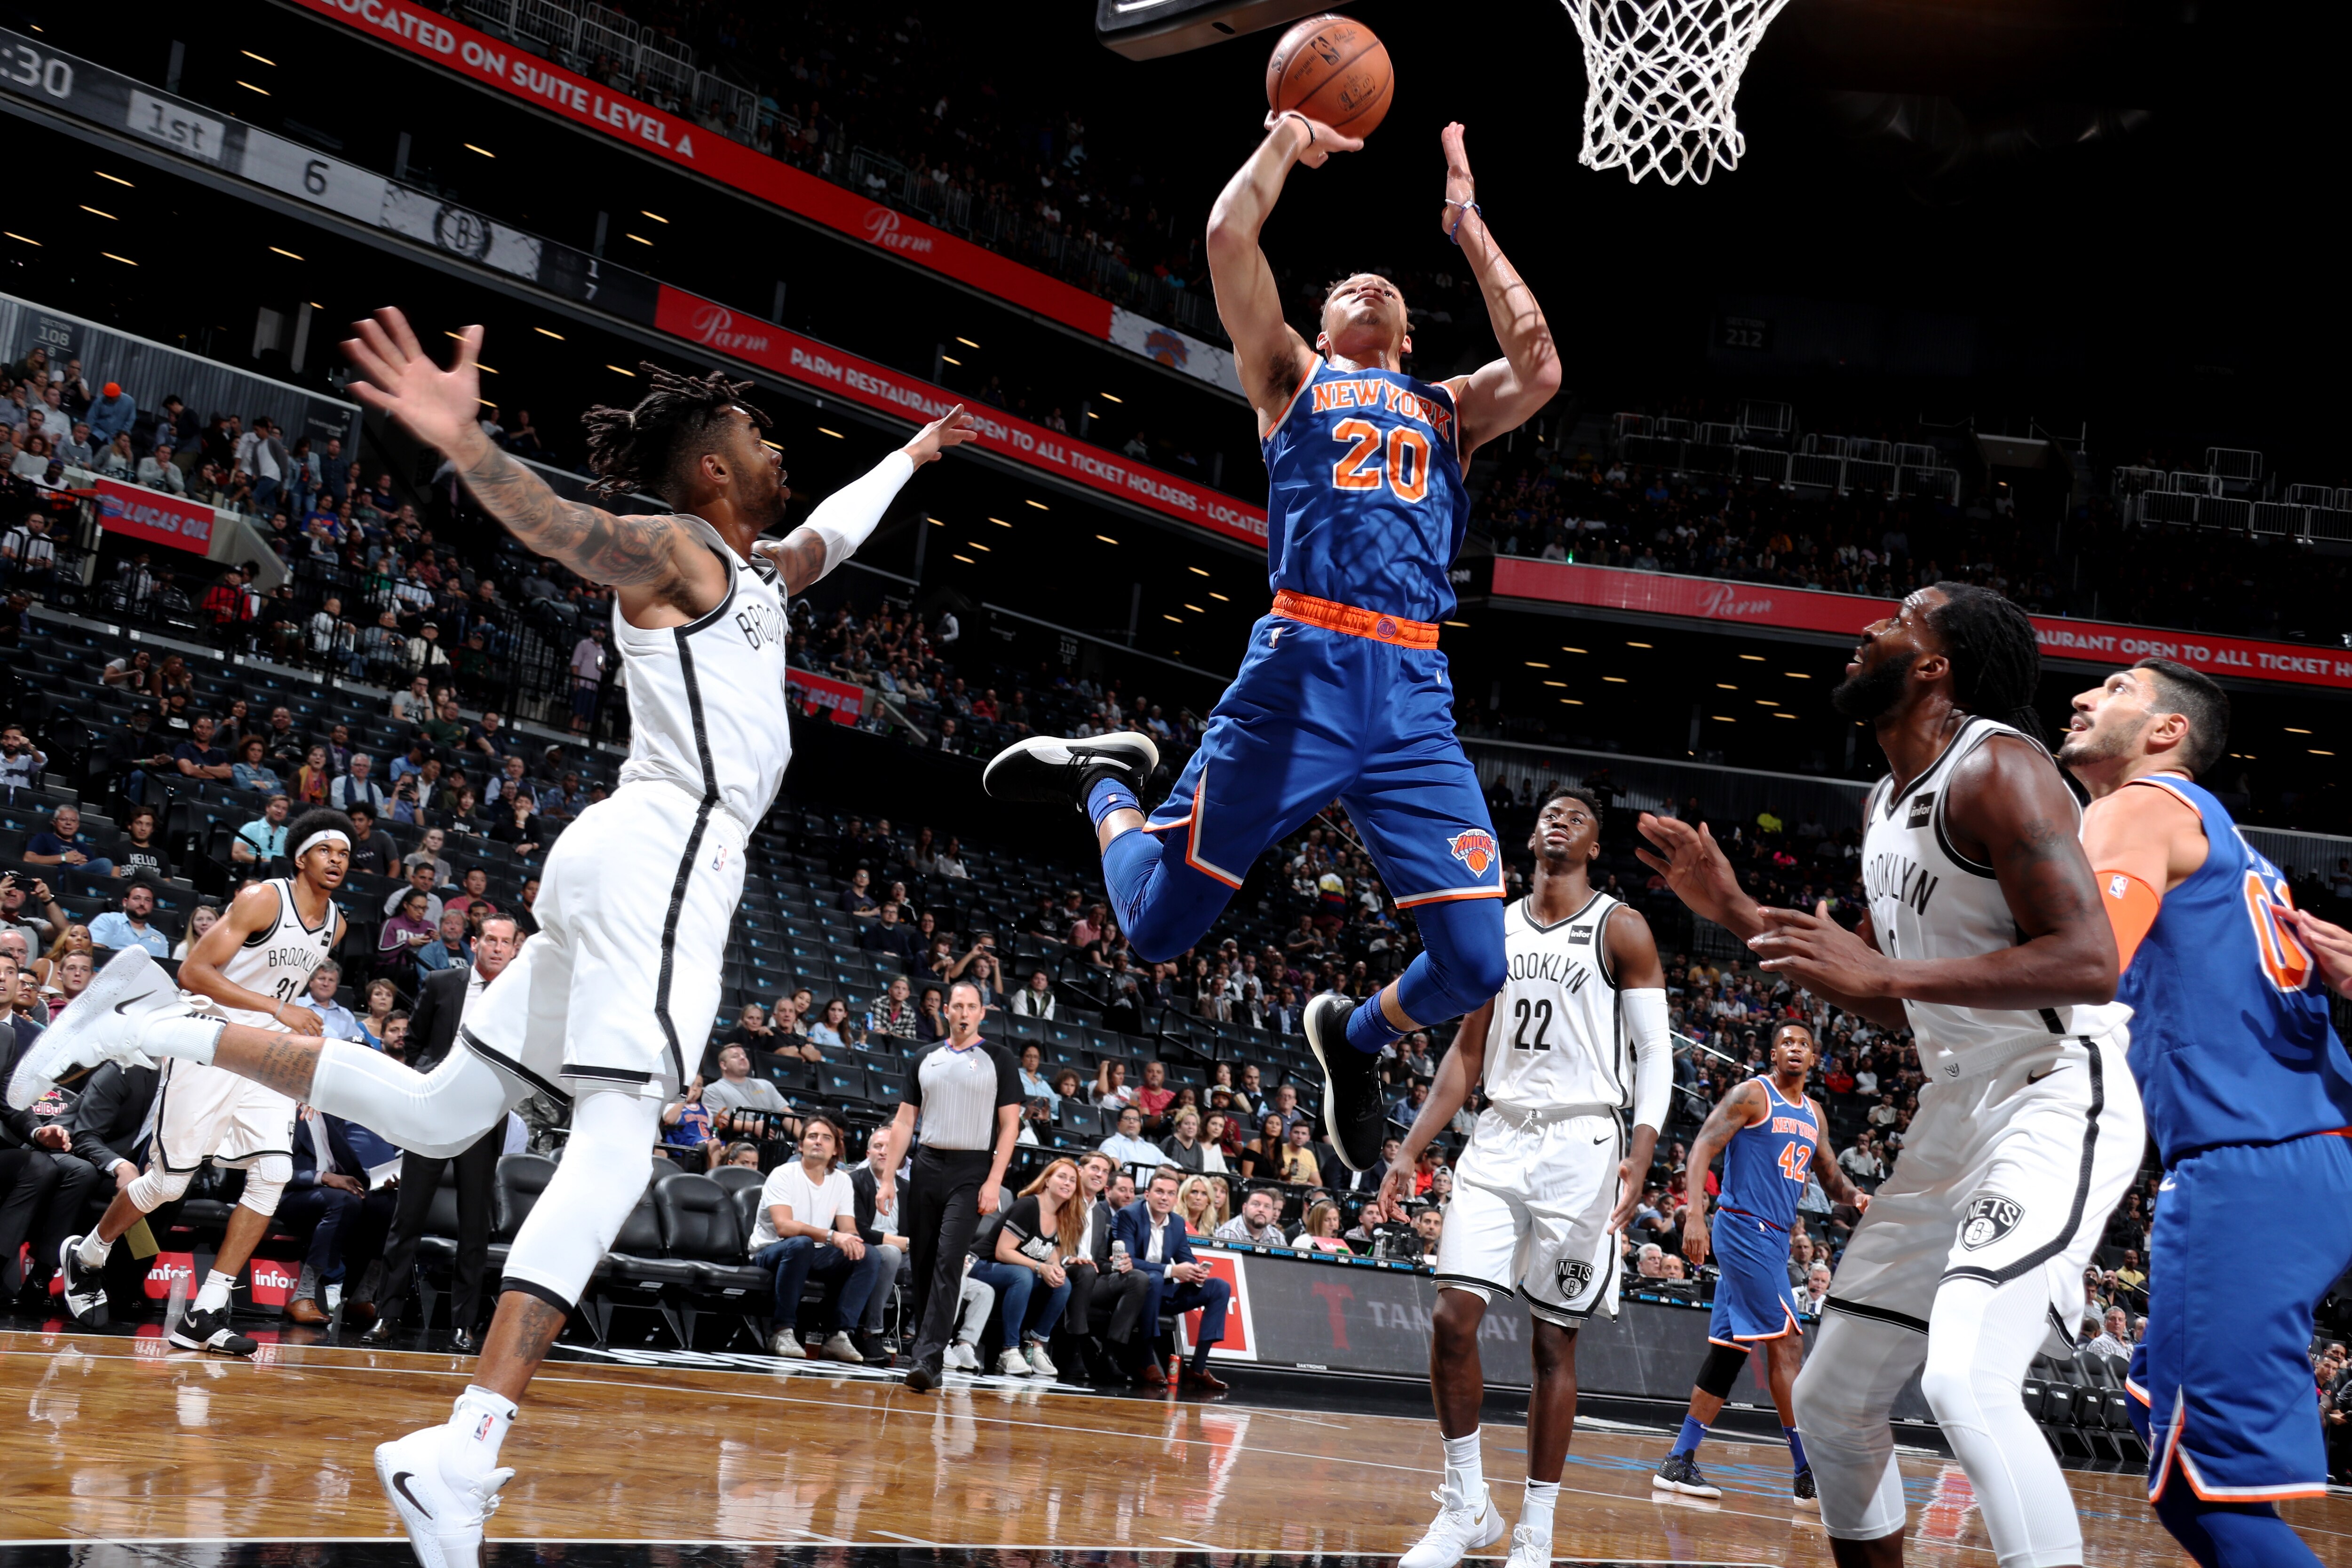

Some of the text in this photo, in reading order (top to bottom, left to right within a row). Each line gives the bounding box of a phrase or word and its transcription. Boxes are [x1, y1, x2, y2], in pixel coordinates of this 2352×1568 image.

[319, 0, 694, 159] OCATED ON SUITE LEVEL A
[148, 103, 205, 151] 1st
[303, 159, 330, 196] 6
[863, 207, 934, 253] Parm
[585, 281, 598, 301] 7
[39, 326, 70, 346] 108
[691, 305, 770, 352] Parm
[1725, 328, 1763, 348] 212
[47, 346, 56, 358] 8
[1311, 378, 1452, 443] NEW YORK
[790, 348, 842, 381] PARM
[1012, 430, 1034, 451] TO
[1037, 441, 1066, 464] ALL
[1071, 451, 1125, 484] TICKET
[1127, 472, 1197, 511] HOLDERS
[1332, 417, 1432, 504] 20
[121, 501, 209, 541] LUCAS OIL
[1695, 582, 1772, 618] Parm
[2034, 625, 2352, 677] AURANT OPEN TO ALL TICKET H
[1910, 804, 1931, 818] infor
[1454, 835, 1494, 855] KNICKS
[129, 853, 158, 867] HELLO
[1571, 930, 1591, 939] infor
[268, 947, 321, 974] BROOKLY
[1500, 952, 1592, 995] ROOKLYN
[270, 977, 299, 1003] 31
[1514, 998, 1552, 1051] 22
[44, 1102, 68, 1116] Bull
[698, 1121, 710, 1138] 6
[1772, 1116, 1797, 1135] NEW
[1778, 1140, 1812, 1183] 42
[1964, 1198, 2018, 1226] NETS
[255, 1269, 298, 1289] infor
[1558, 1262, 1591, 1281] NETS
[1568, 1280, 1575, 1294] B
